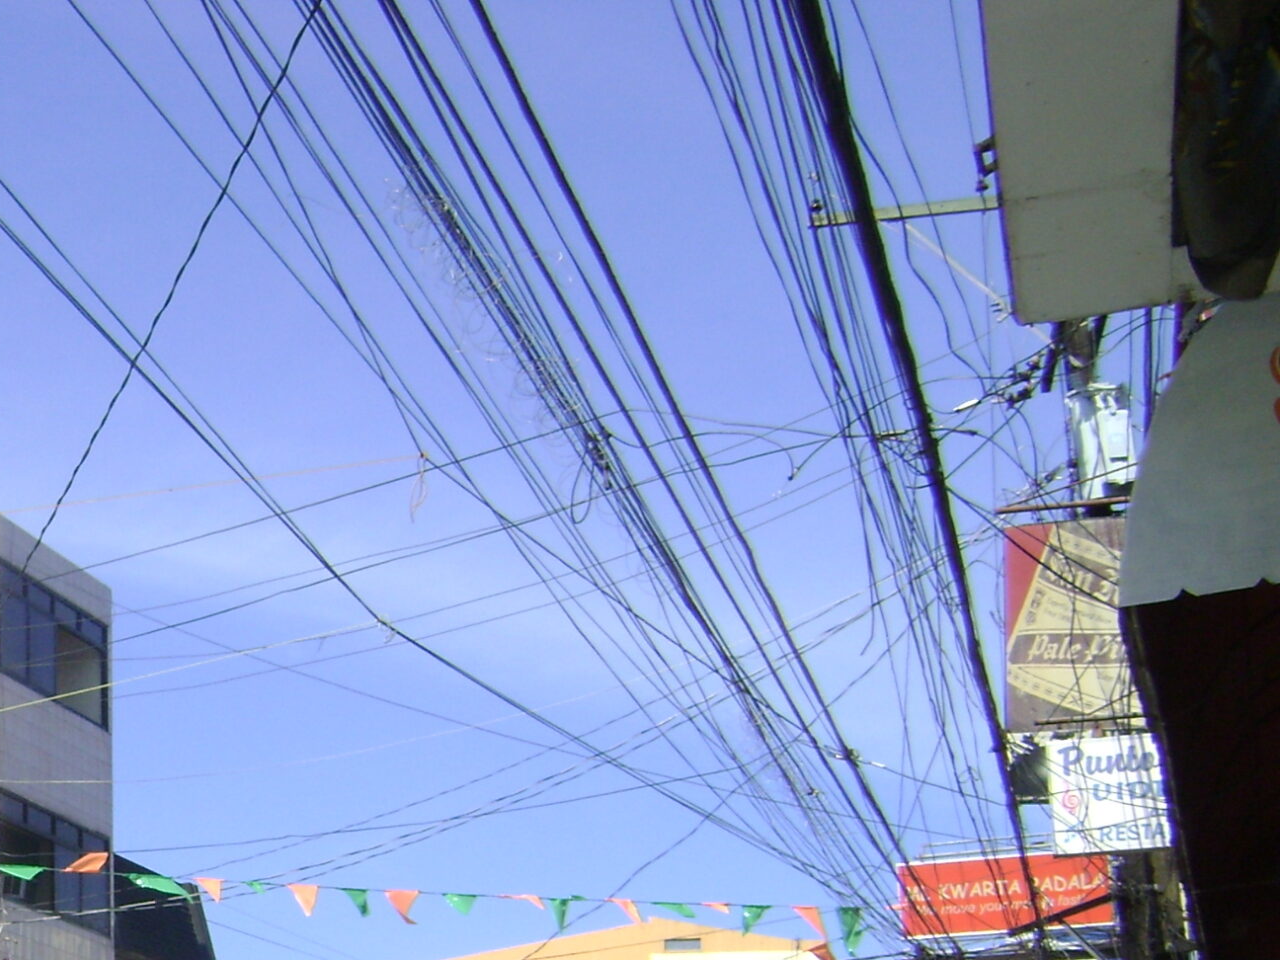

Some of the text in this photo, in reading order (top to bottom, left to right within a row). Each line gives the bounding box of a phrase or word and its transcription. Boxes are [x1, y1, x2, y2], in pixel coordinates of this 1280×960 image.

[1028, 635, 1082, 663] Pale
[1100, 822, 1166, 842] RESTA
[938, 879, 1022, 900] KWARTA
[940, 904, 977, 915] move
